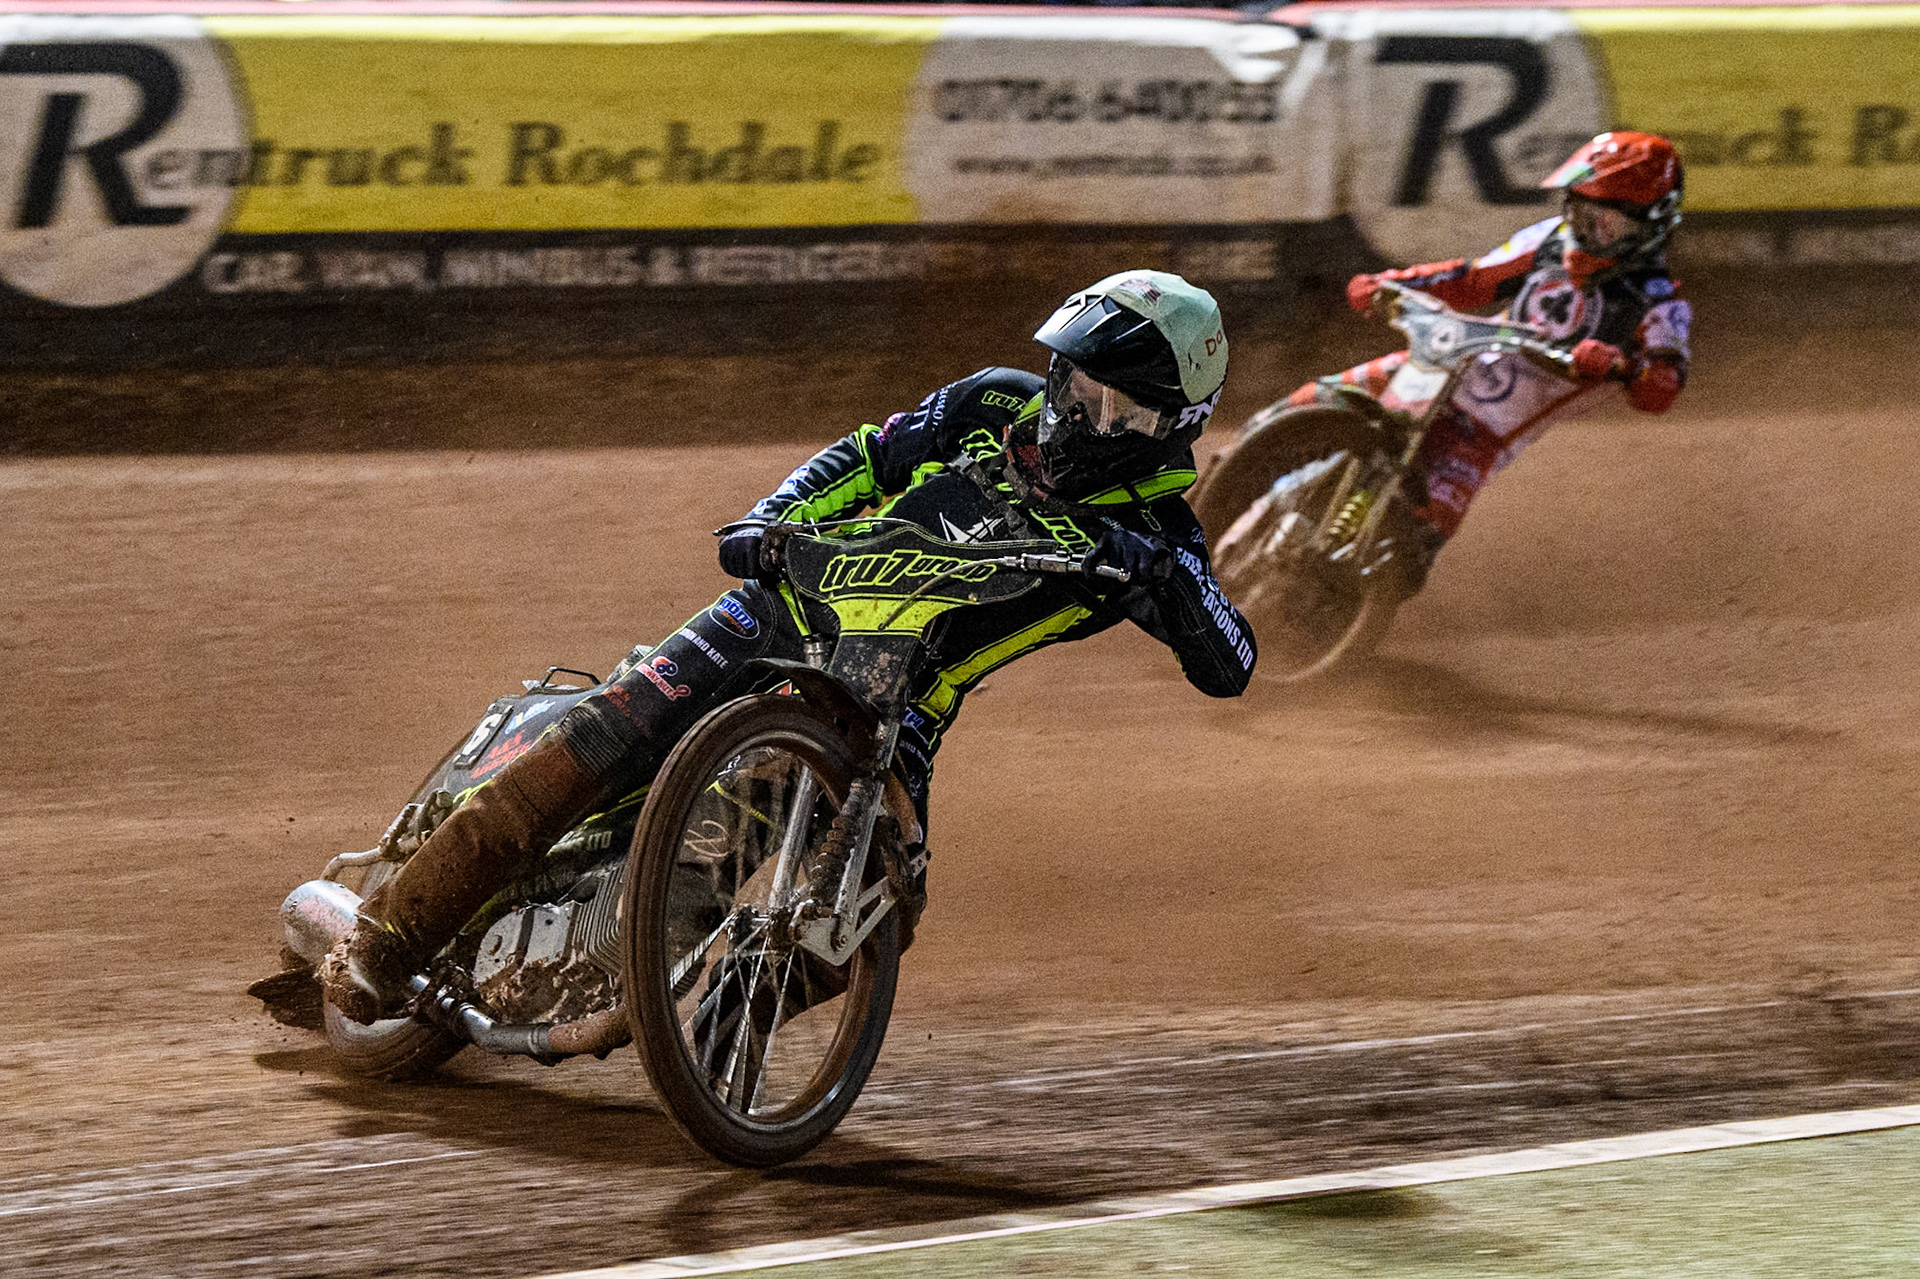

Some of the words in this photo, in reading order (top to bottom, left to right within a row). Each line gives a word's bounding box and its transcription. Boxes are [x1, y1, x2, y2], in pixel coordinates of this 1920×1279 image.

[503, 120, 882, 187] Rochdale
[706, 645, 729, 669] KATE
[1236, 637, 1254, 671] LTD
